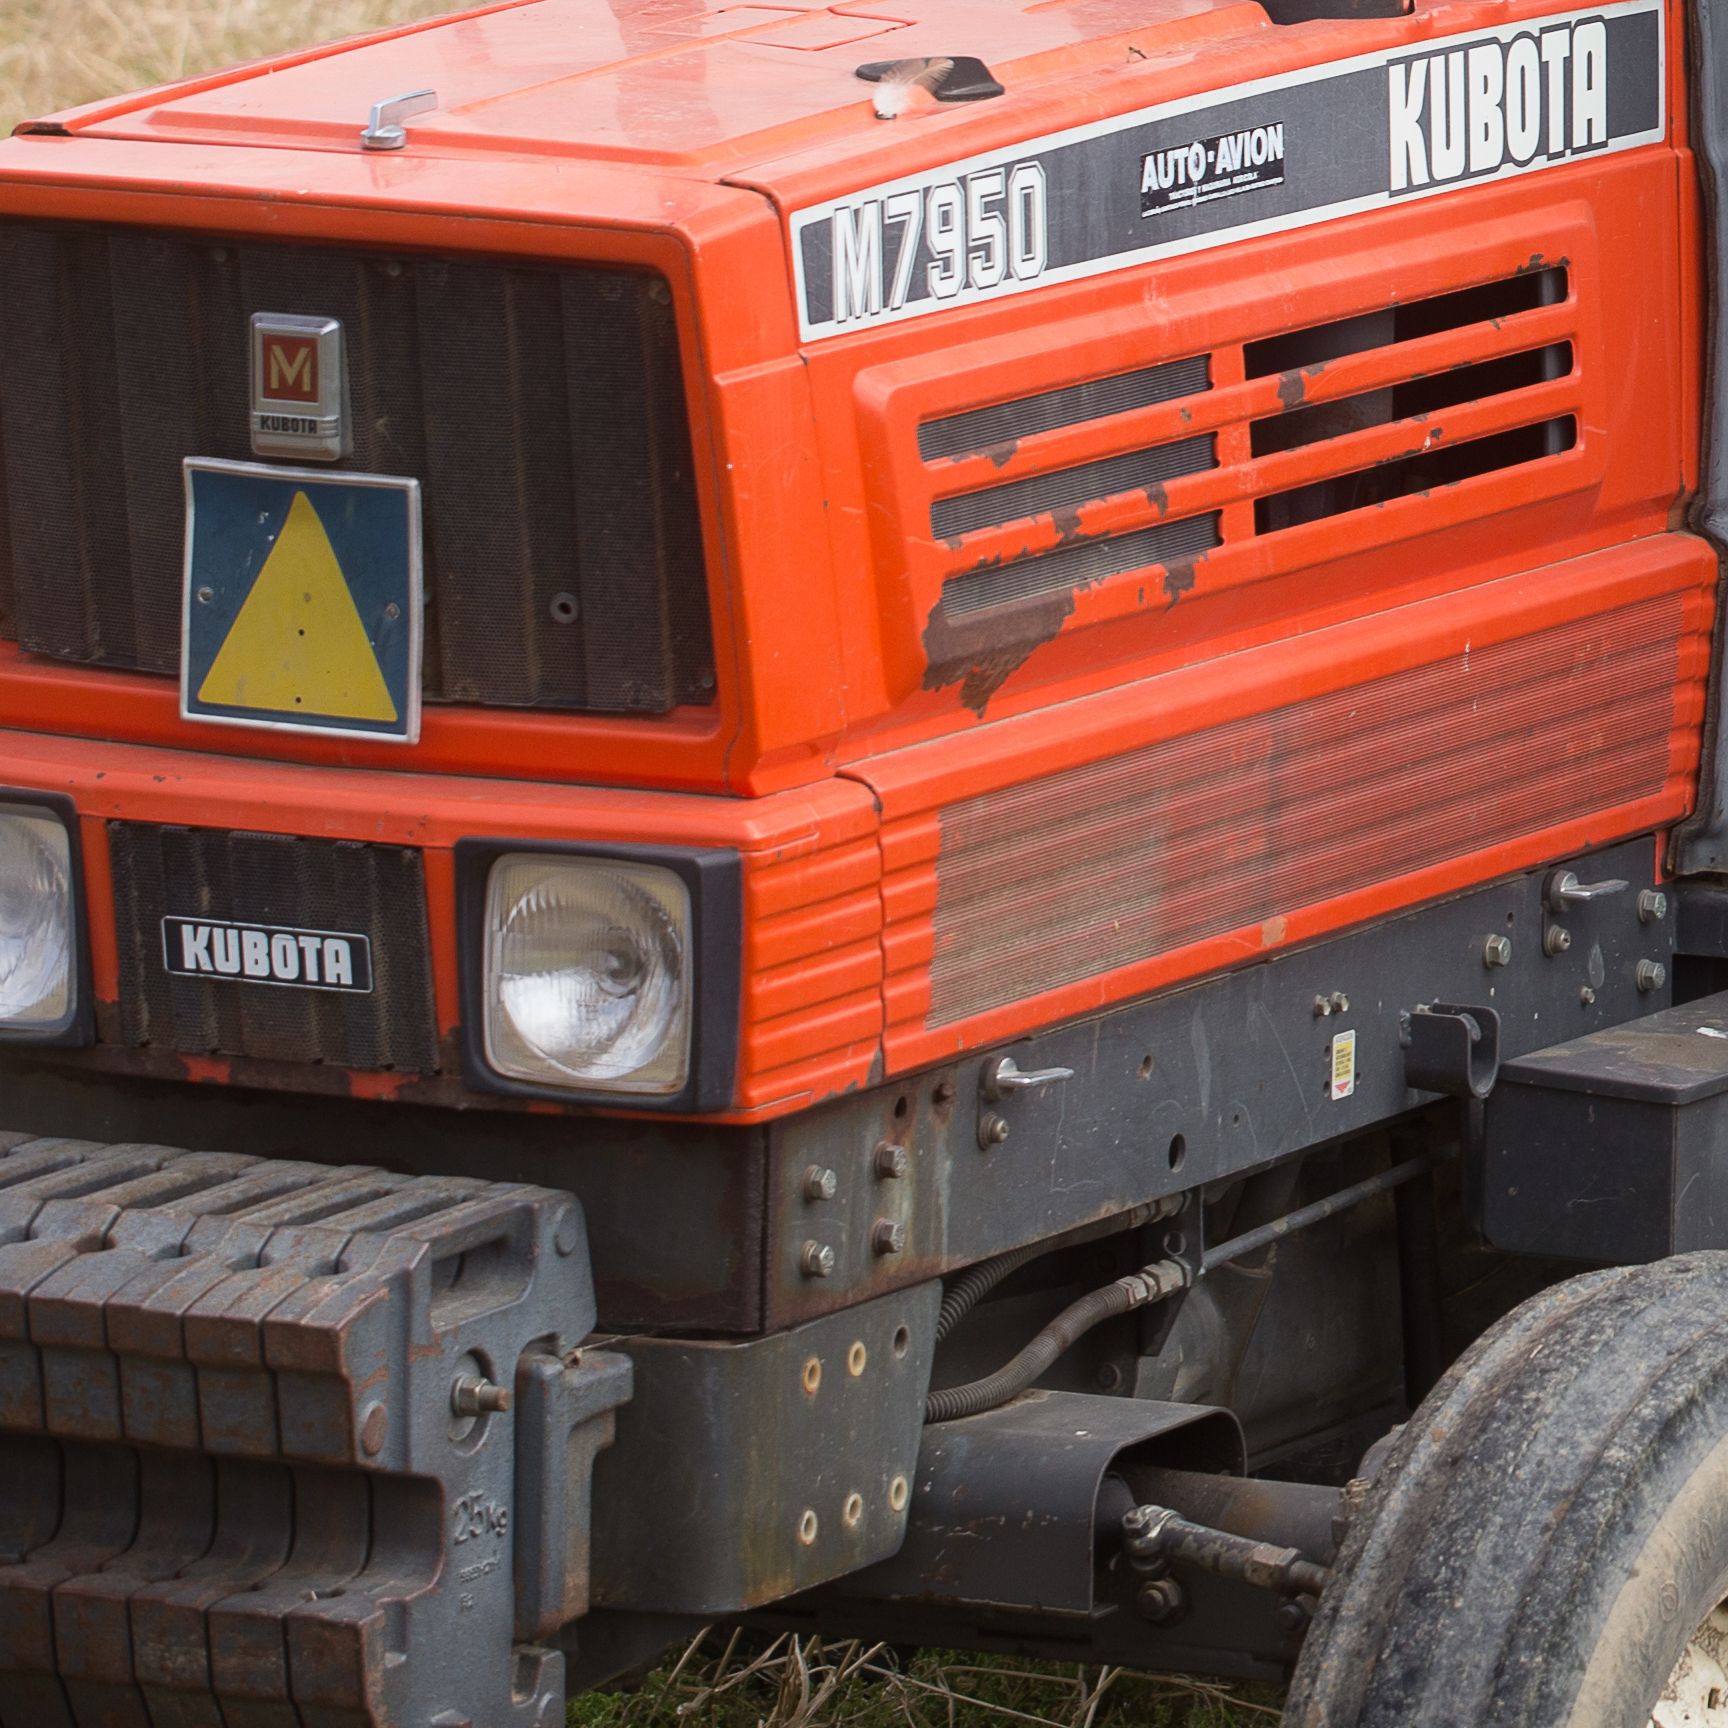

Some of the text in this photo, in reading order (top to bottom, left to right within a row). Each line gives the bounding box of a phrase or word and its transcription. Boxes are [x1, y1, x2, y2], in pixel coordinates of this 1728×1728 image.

[1389, 20, 1608, 188] KUBOTA
[832, 161, 1050, 322] M7950
[270, 344, 312, 392] M
[260, 415, 318, 435] KUBOTA
[180, 924, 353, 986] KUBOTA
